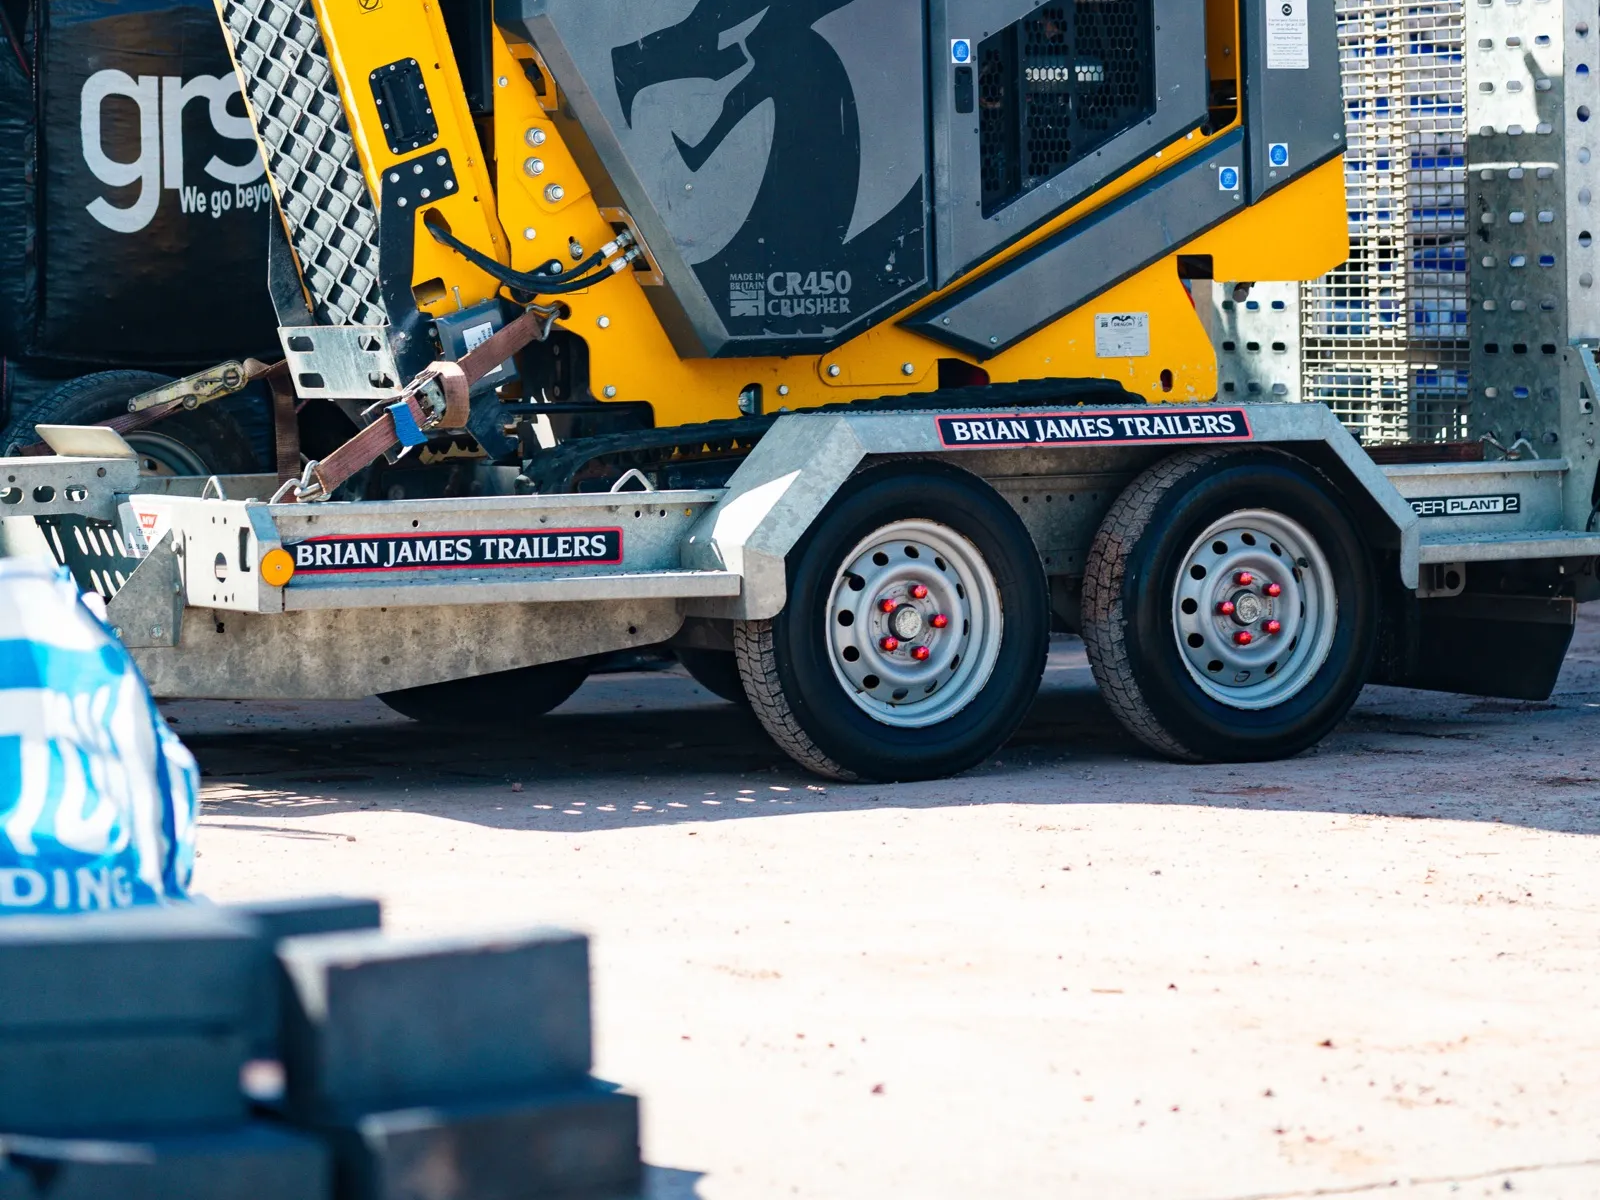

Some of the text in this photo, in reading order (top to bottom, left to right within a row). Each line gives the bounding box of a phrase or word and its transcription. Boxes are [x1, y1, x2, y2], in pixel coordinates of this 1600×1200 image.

[80, 68, 266, 233] grs
[180, 186, 206, 213] We
[211, 188, 231, 218] go
[766, 270, 852, 297] CR450
[767, 298, 851, 317] CRUSHER
[951, 414, 1236, 443] BRIAN JAMES TRAILERS
[1451, 500, 1500, 511] PLANT
[1505, 497, 1518, 511] 2
[296, 535, 607, 568] BRIAN JAMES TRAILERS
